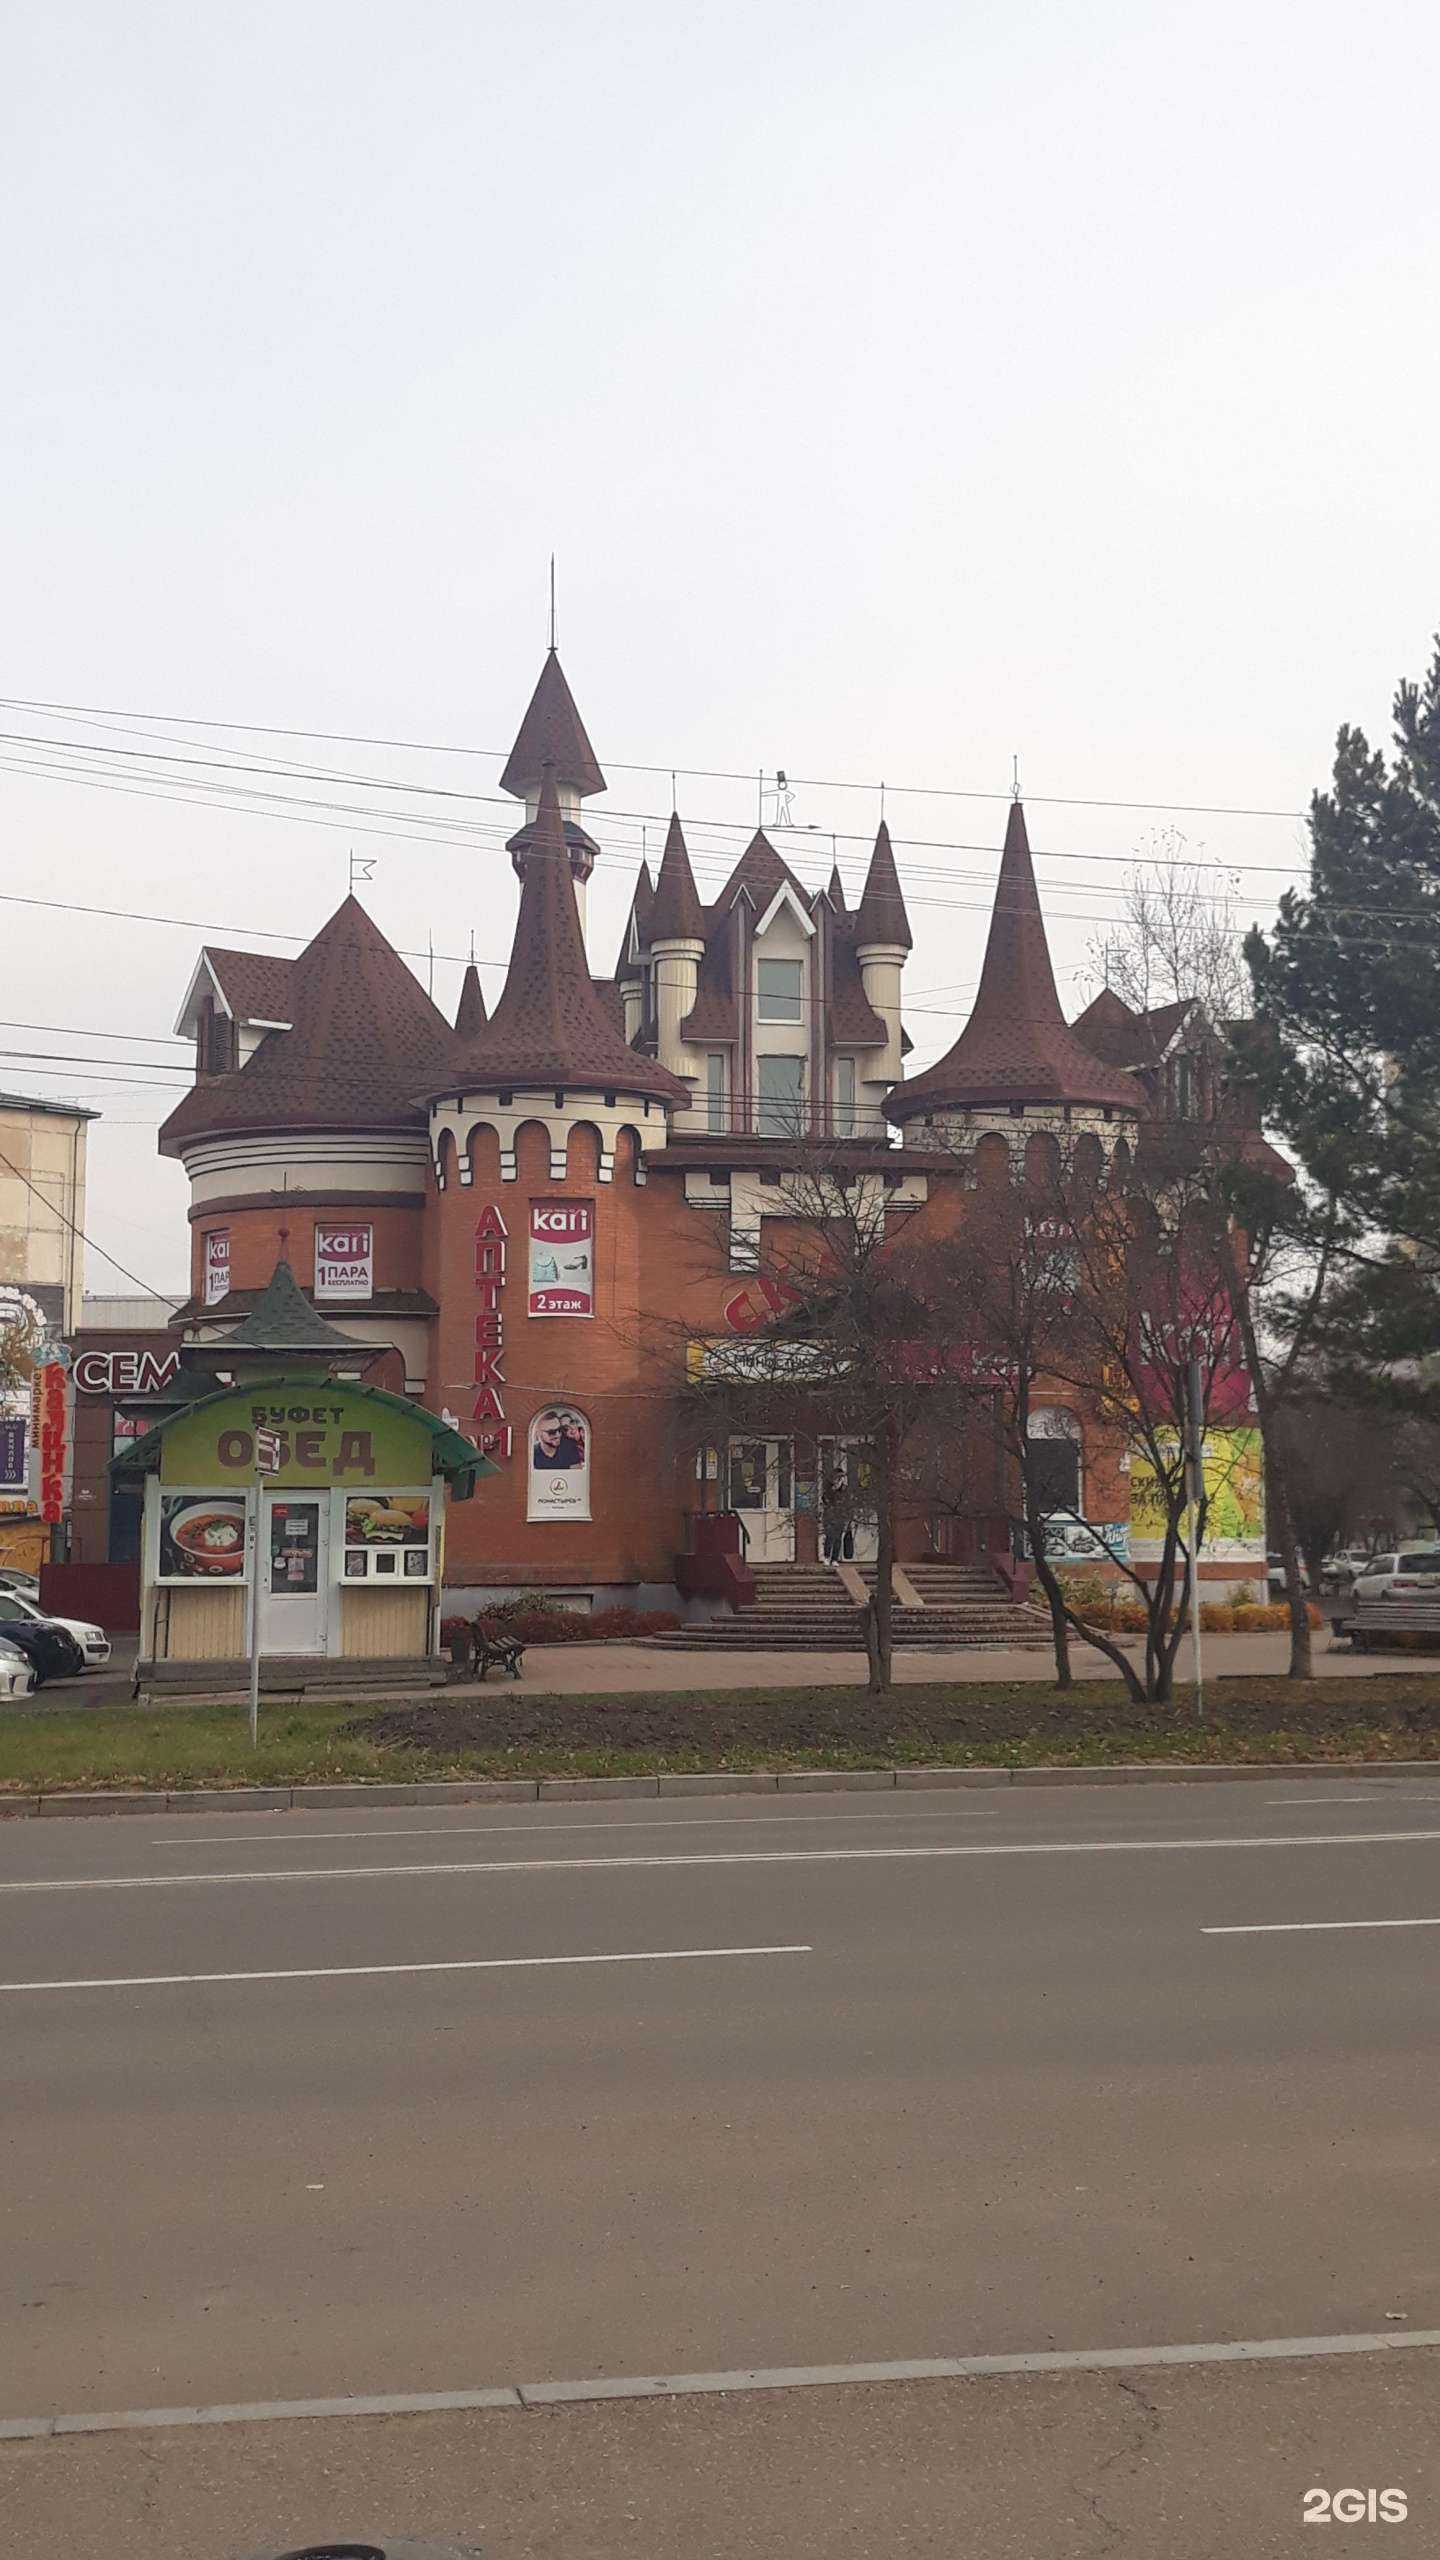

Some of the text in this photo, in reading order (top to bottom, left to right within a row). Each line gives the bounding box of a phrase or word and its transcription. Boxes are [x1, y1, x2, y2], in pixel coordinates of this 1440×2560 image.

[533, 1208, 588, 1231] kari
[319, 1232, 369, 1253] kari
[328, 1266, 369, 1278] ПАРА
[537, 1294, 582, 1310] 2 этаж
[474, 1205, 509, 1423] АПТЕКА
[251, 1406, 345, 1424] БУФЕТ
